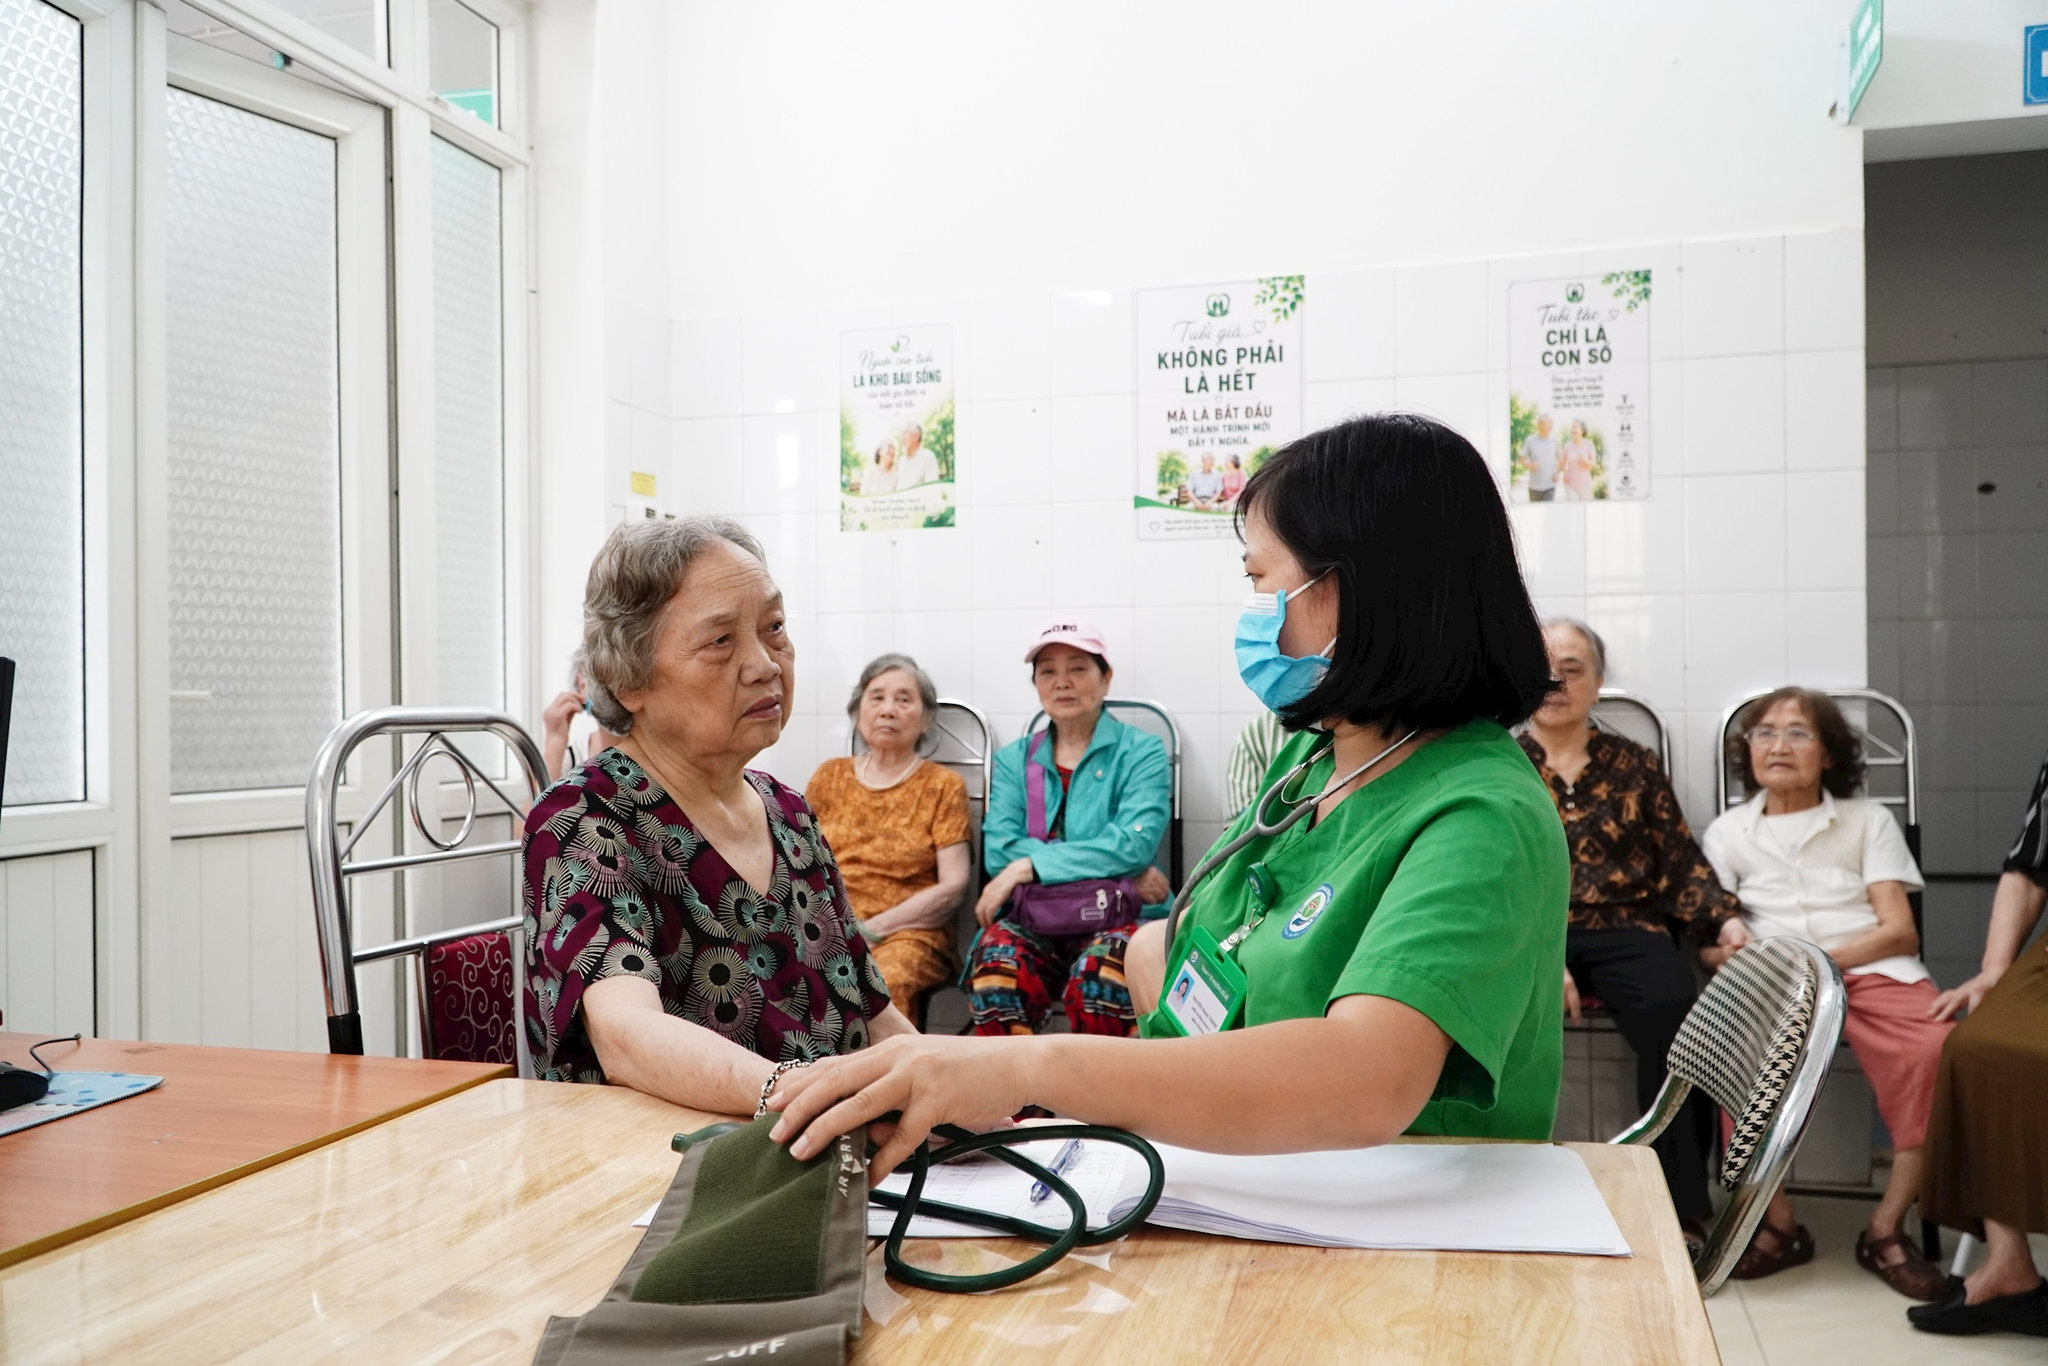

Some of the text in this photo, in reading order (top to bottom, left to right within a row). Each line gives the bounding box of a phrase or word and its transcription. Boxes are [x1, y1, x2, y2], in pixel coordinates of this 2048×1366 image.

[1546, 323, 1607, 345] CHỈ LÀ
[1158, 339, 1284, 370] KHÔNG PHẢI
[1542, 341, 1612, 366] CON SỐ
[1185, 367, 1256, 394] LÀ HẾT
[1193, 406, 1209, 421] LÀ
[838, 1134, 853, 1198] ARTERY
[705, 1338, 787, 1361] UFF
